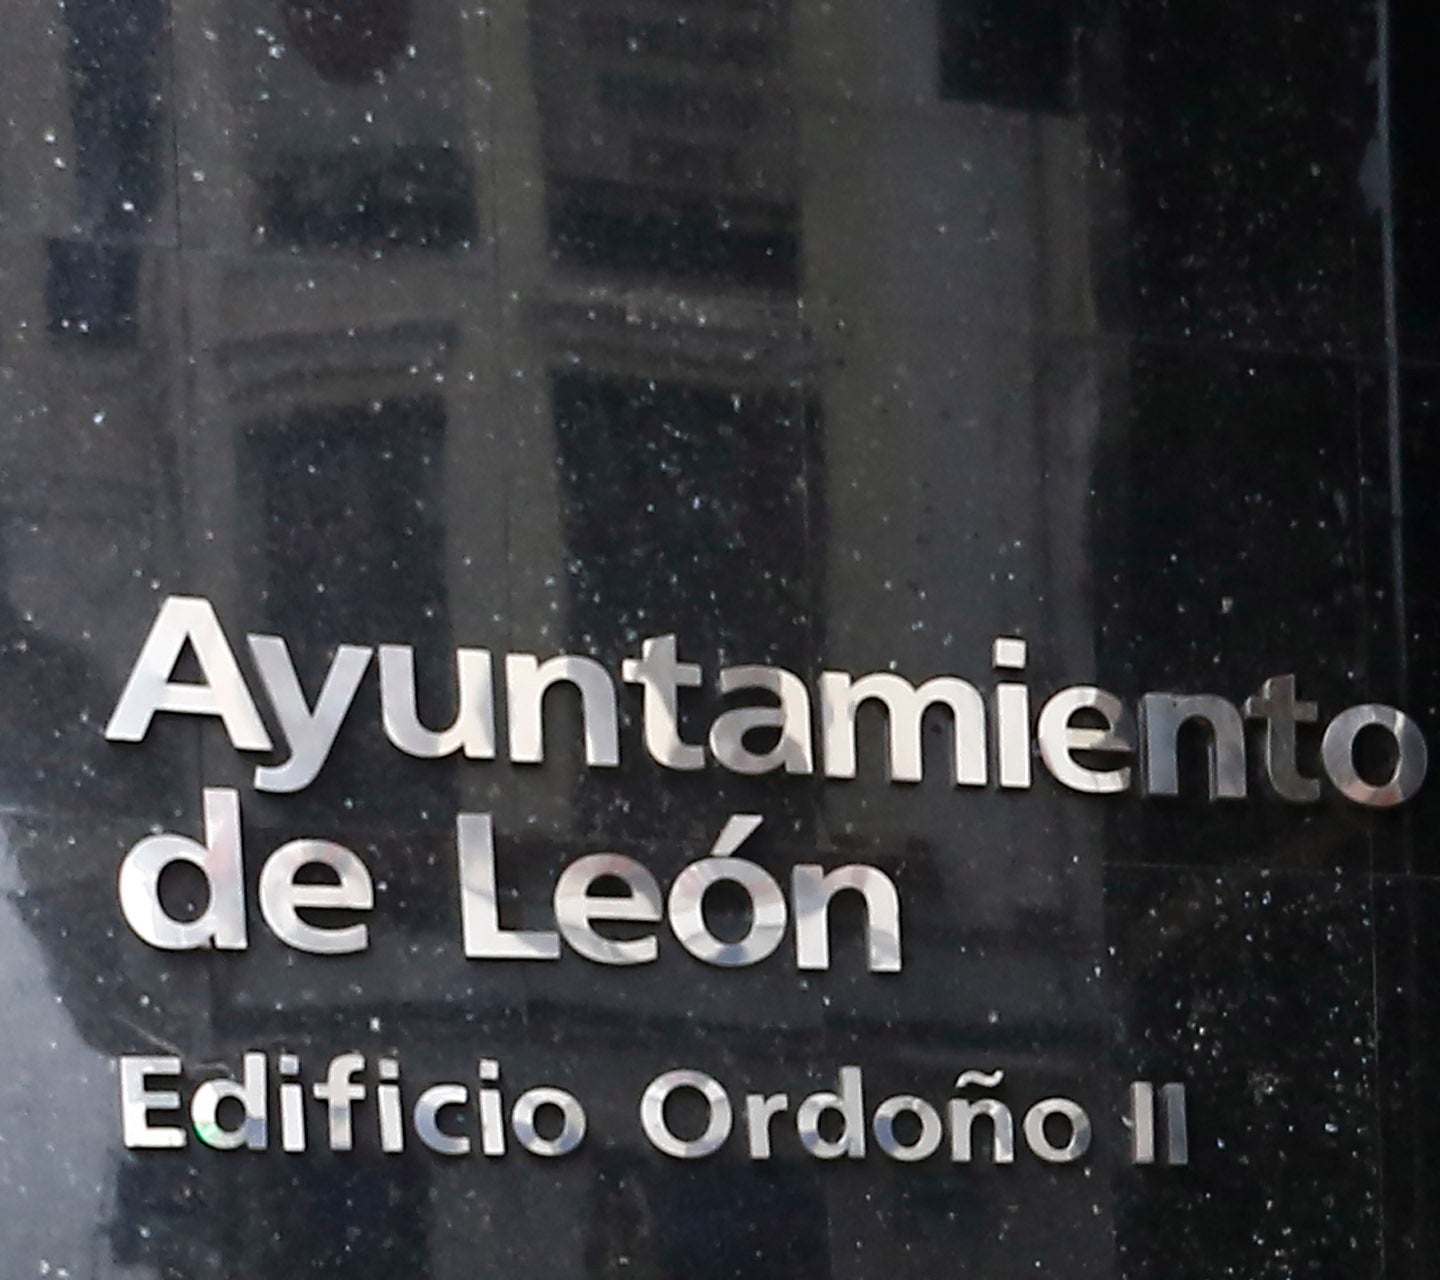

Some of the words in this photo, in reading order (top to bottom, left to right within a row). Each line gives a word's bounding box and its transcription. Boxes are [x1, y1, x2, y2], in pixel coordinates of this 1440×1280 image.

[102, 593, 1431, 811] Ayuntamiento
[118, 786, 380, 957] de
[455, 811, 905, 975] León
[118, 1050, 588, 1159] Edificio
[639, 1066, 1094, 1168] Ordoño
[1127, 1081, 1189, 1168] II
